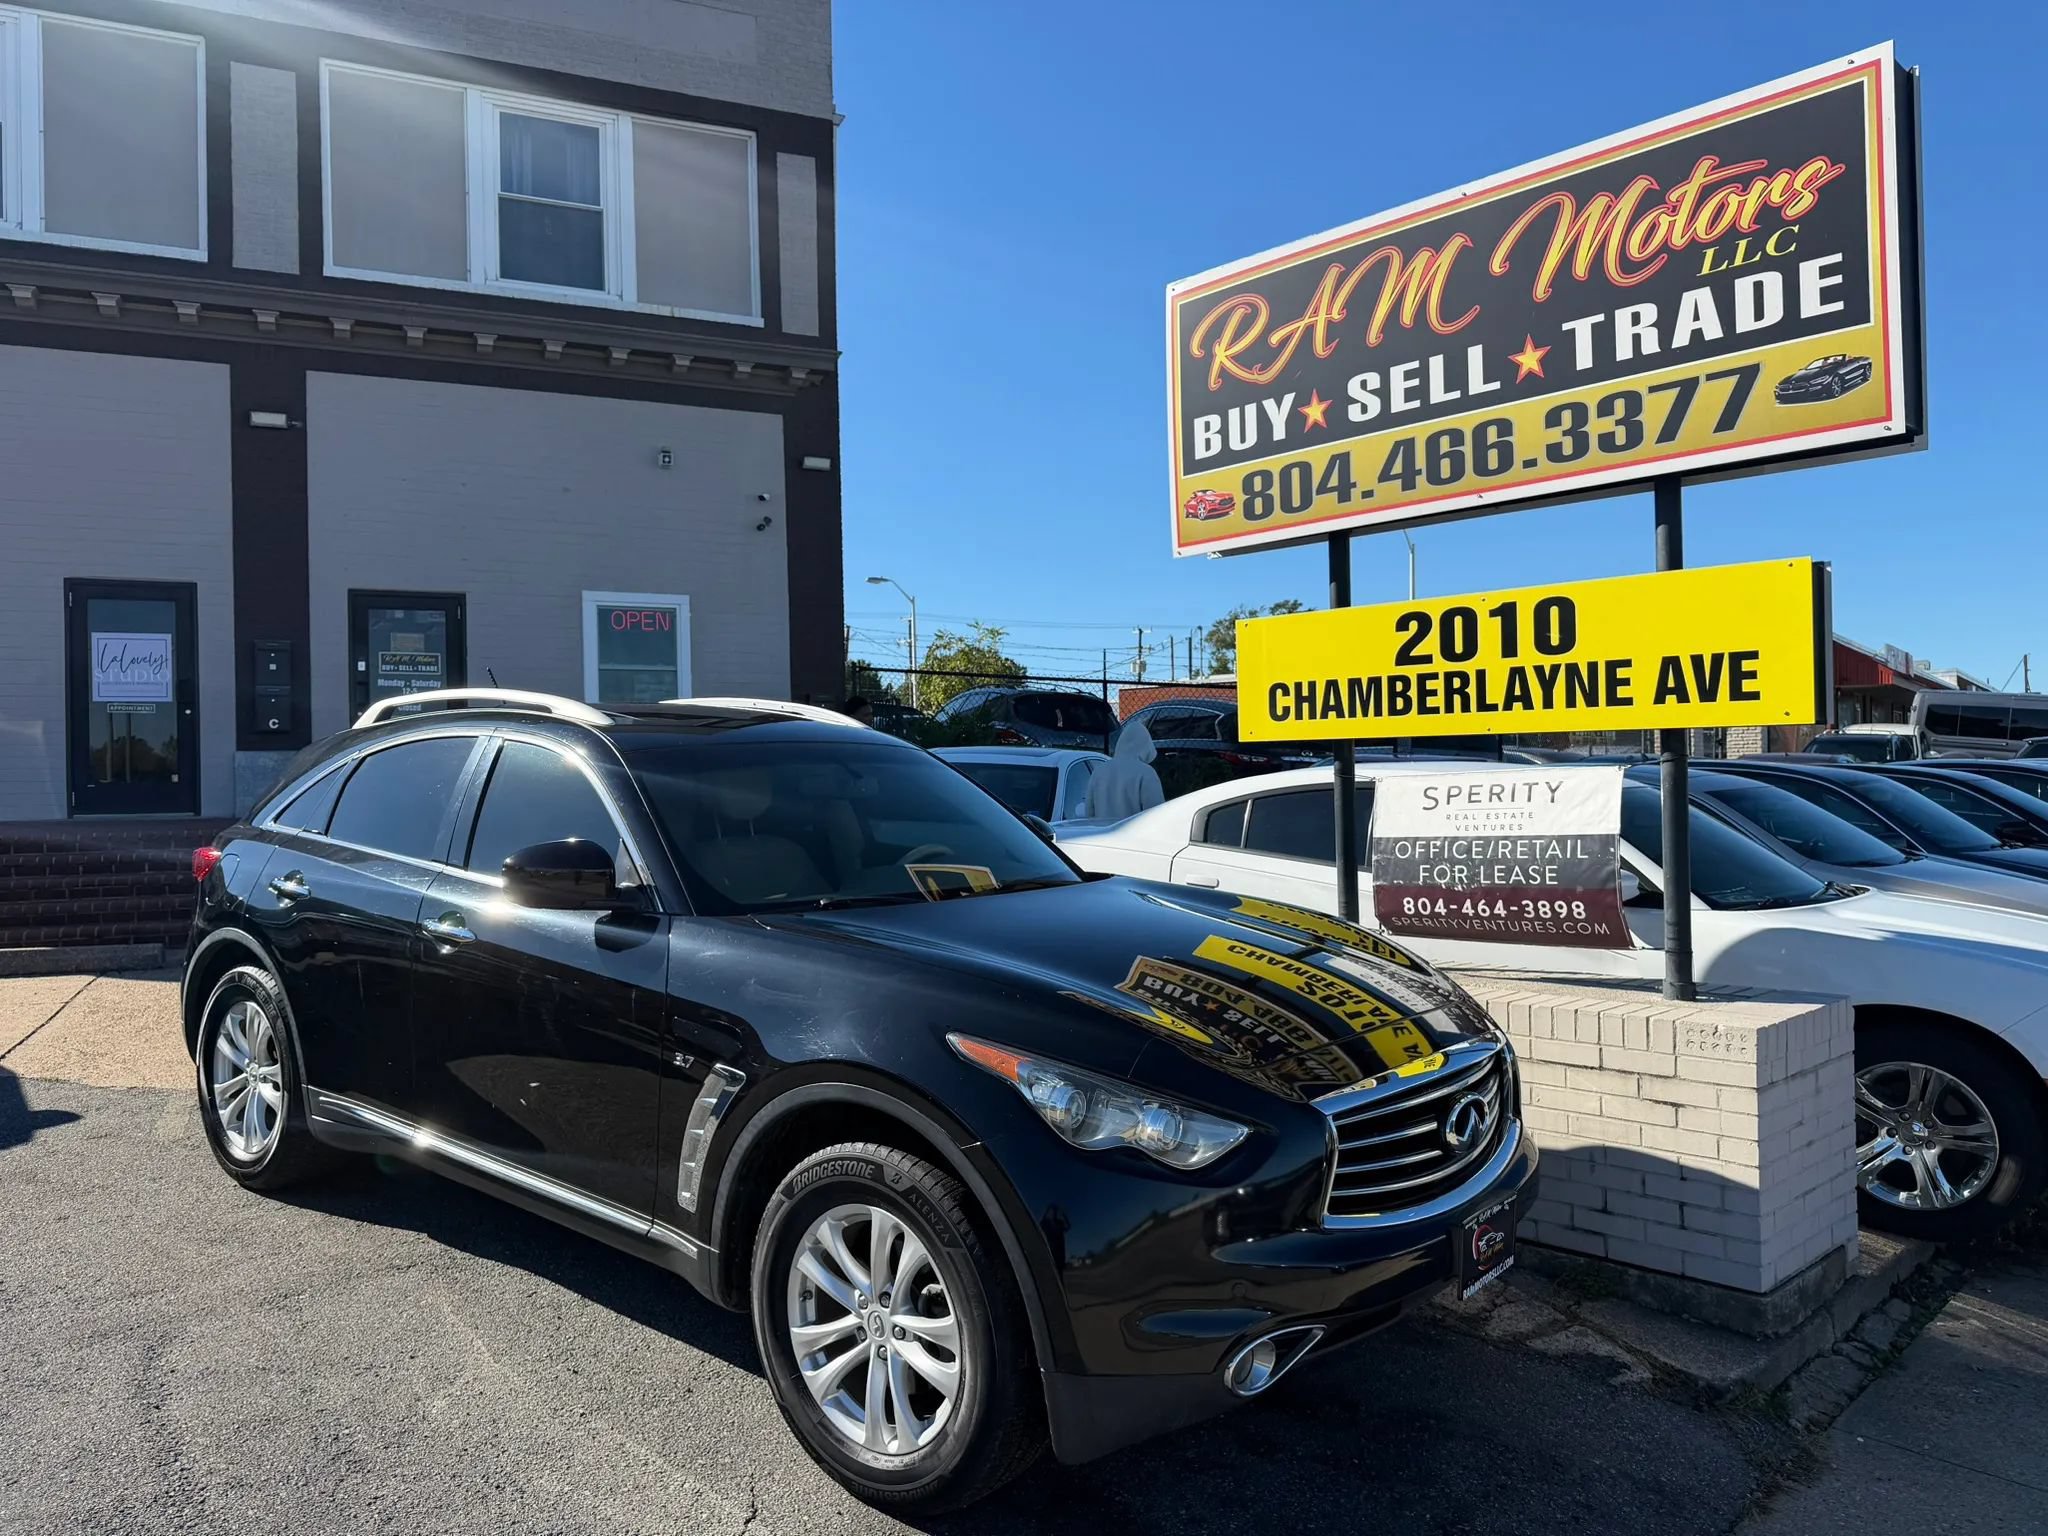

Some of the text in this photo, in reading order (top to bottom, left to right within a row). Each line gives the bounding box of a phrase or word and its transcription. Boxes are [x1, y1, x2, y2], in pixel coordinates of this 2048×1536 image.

[1696, 224, 1800, 277] LLC
[1190, 155, 1845, 390] RAM Motors
[1194, 252, 1845, 460] BUY SELL TRADE
[1241, 362, 1761, 522] 804.466.3377
[611, 610, 669, 631] OPEN
[1395, 596, 1577, 666] 2010
[377, 679, 405, 687] Monday
[411, 679, 441, 688] Saturday
[1268, 650, 1761, 723] CHAMBERLAYNE AVE
[268, 718, 279, 729] C
[1422, 780, 1564, 811] SPERITY
[1446, 811, 1534, 821] REAL ESTATE
[1455, 823, 1524, 832] VENTURES
[1395, 839, 1589, 859] OFFICE/RETAIL
[1419, 865, 1559, 885] FOR LEASE
[1403, 897, 1587, 919] 804-464-3898
[1392, 916, 1610, 935] SPERITYVENTURES.COM
[792, 1160, 875, 1194] BRIDGESTONE
[908, 1193, 949, 1243] ALENZA
